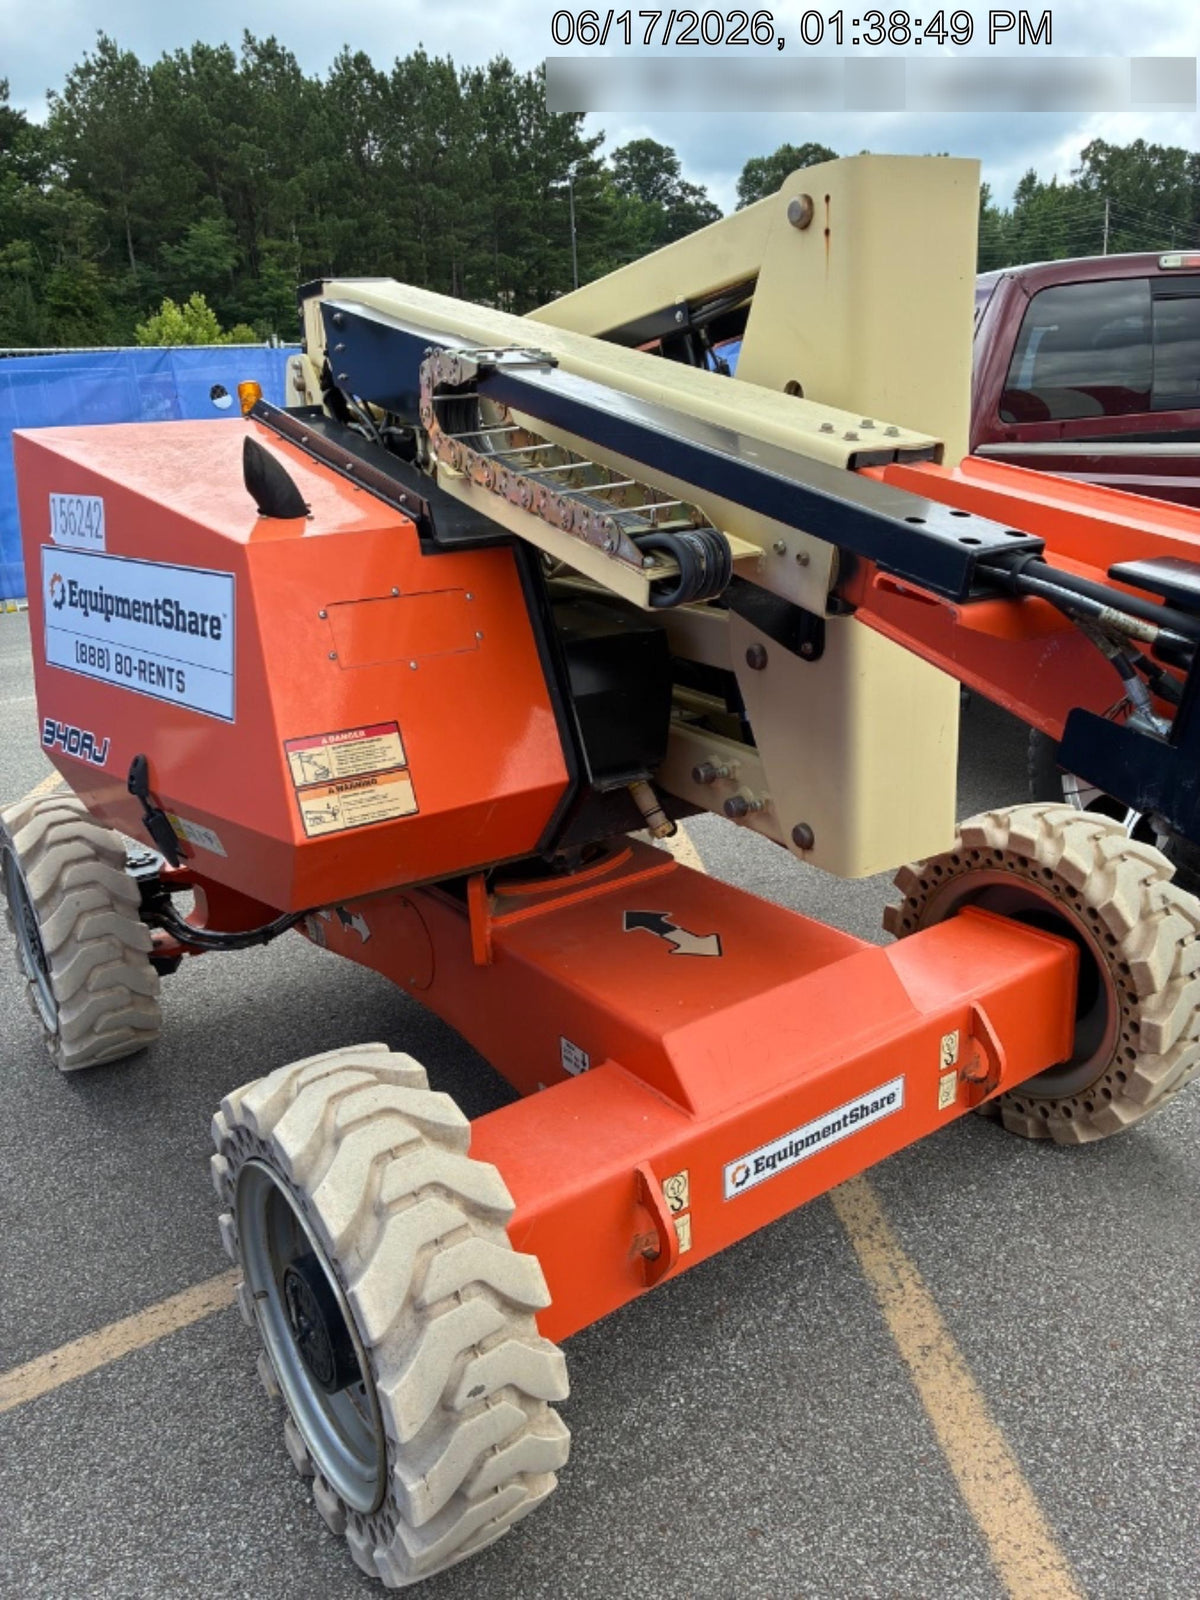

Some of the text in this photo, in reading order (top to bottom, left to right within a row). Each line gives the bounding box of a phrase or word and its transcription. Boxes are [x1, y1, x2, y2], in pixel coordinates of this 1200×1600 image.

[51, 497, 104, 539] 156242
[67, 579, 222, 641] EquipmentShare
[75, 640, 186, 693] (888) 80-RENTS
[43, 718, 110, 766] 340AJ
[753, 1090, 897, 1176] EquipmentShare
